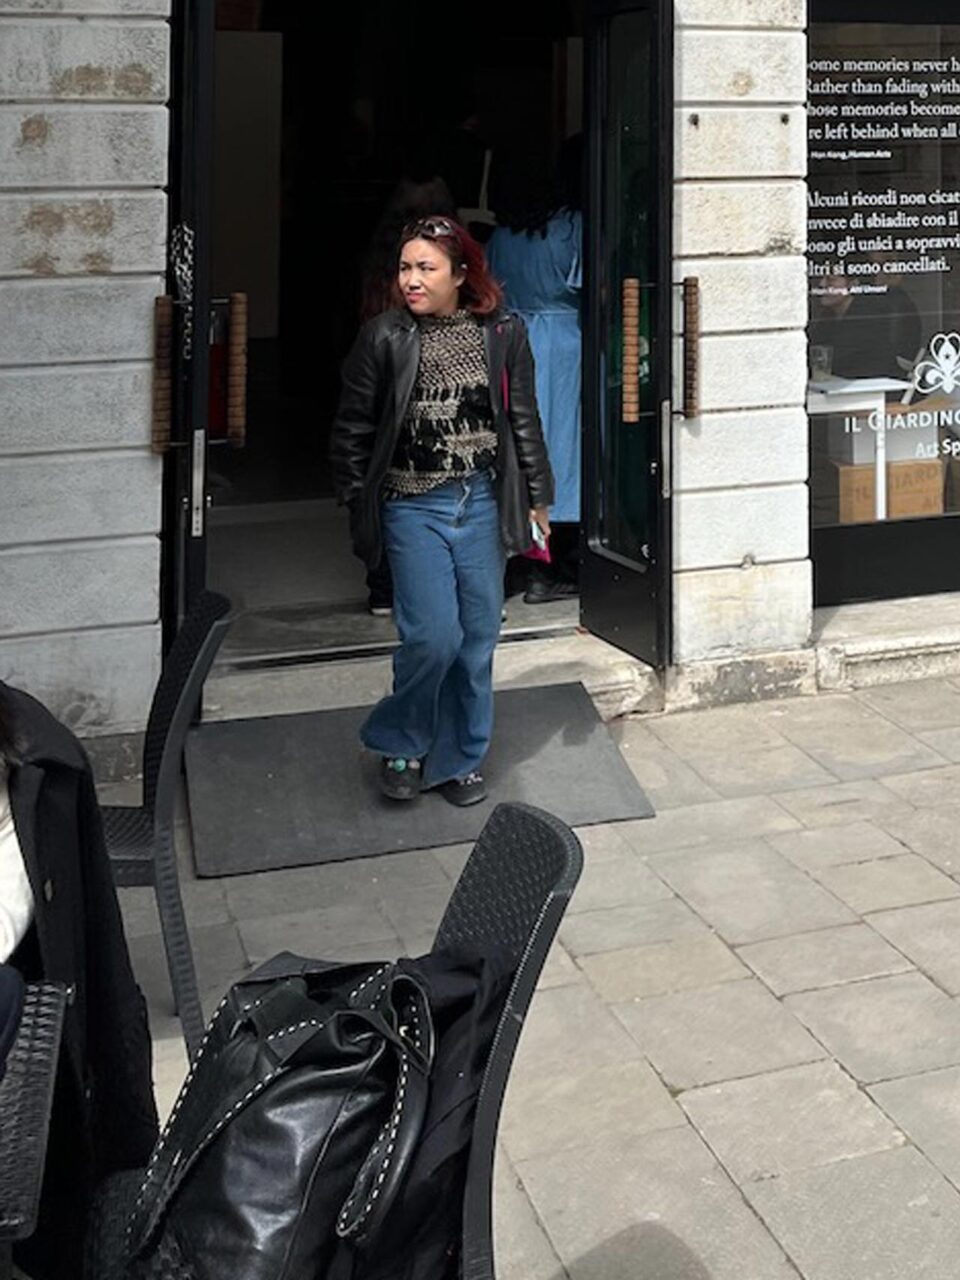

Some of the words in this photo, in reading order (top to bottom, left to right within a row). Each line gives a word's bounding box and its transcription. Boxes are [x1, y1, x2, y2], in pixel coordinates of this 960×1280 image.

[807, 60, 840, 72] ome
[843, 59, 909, 72] memories
[912, 61, 948, 72] never
[852, 78, 883, 94] than
[885, 78, 928, 98] fading
[930, 78, 960, 94] with
[807, 100, 838, 116] hose
[841, 100, 908, 116] memories
[910, 100, 960, 116] become
[808, 128, 823, 139] re
[825, 122, 848, 140] left
[851, 122, 899, 139] behind
[901, 122, 938, 138] when
[940, 122, 957, 138] all
[851, 191, 897, 207] ricordi
[900, 193, 926, 206] non
[808, 218, 847, 230] nvece
[849, 213, 865, 229] di
[866, 213, 920, 229] sbiadire
[922, 215, 947, 228] con
[948, 212, 959, 227] il
[807, 241, 835, 253] ono
[837, 235, 856, 257] gli
[858, 235, 893, 251] unici
[895, 239, 904, 251] a
[808, 260, 831, 276] ltri
[833, 261, 845, 275] si
[847, 263, 880, 275] sono
[882, 256, 951, 273] cancellati.
[845, 416, 862, 434] IL
